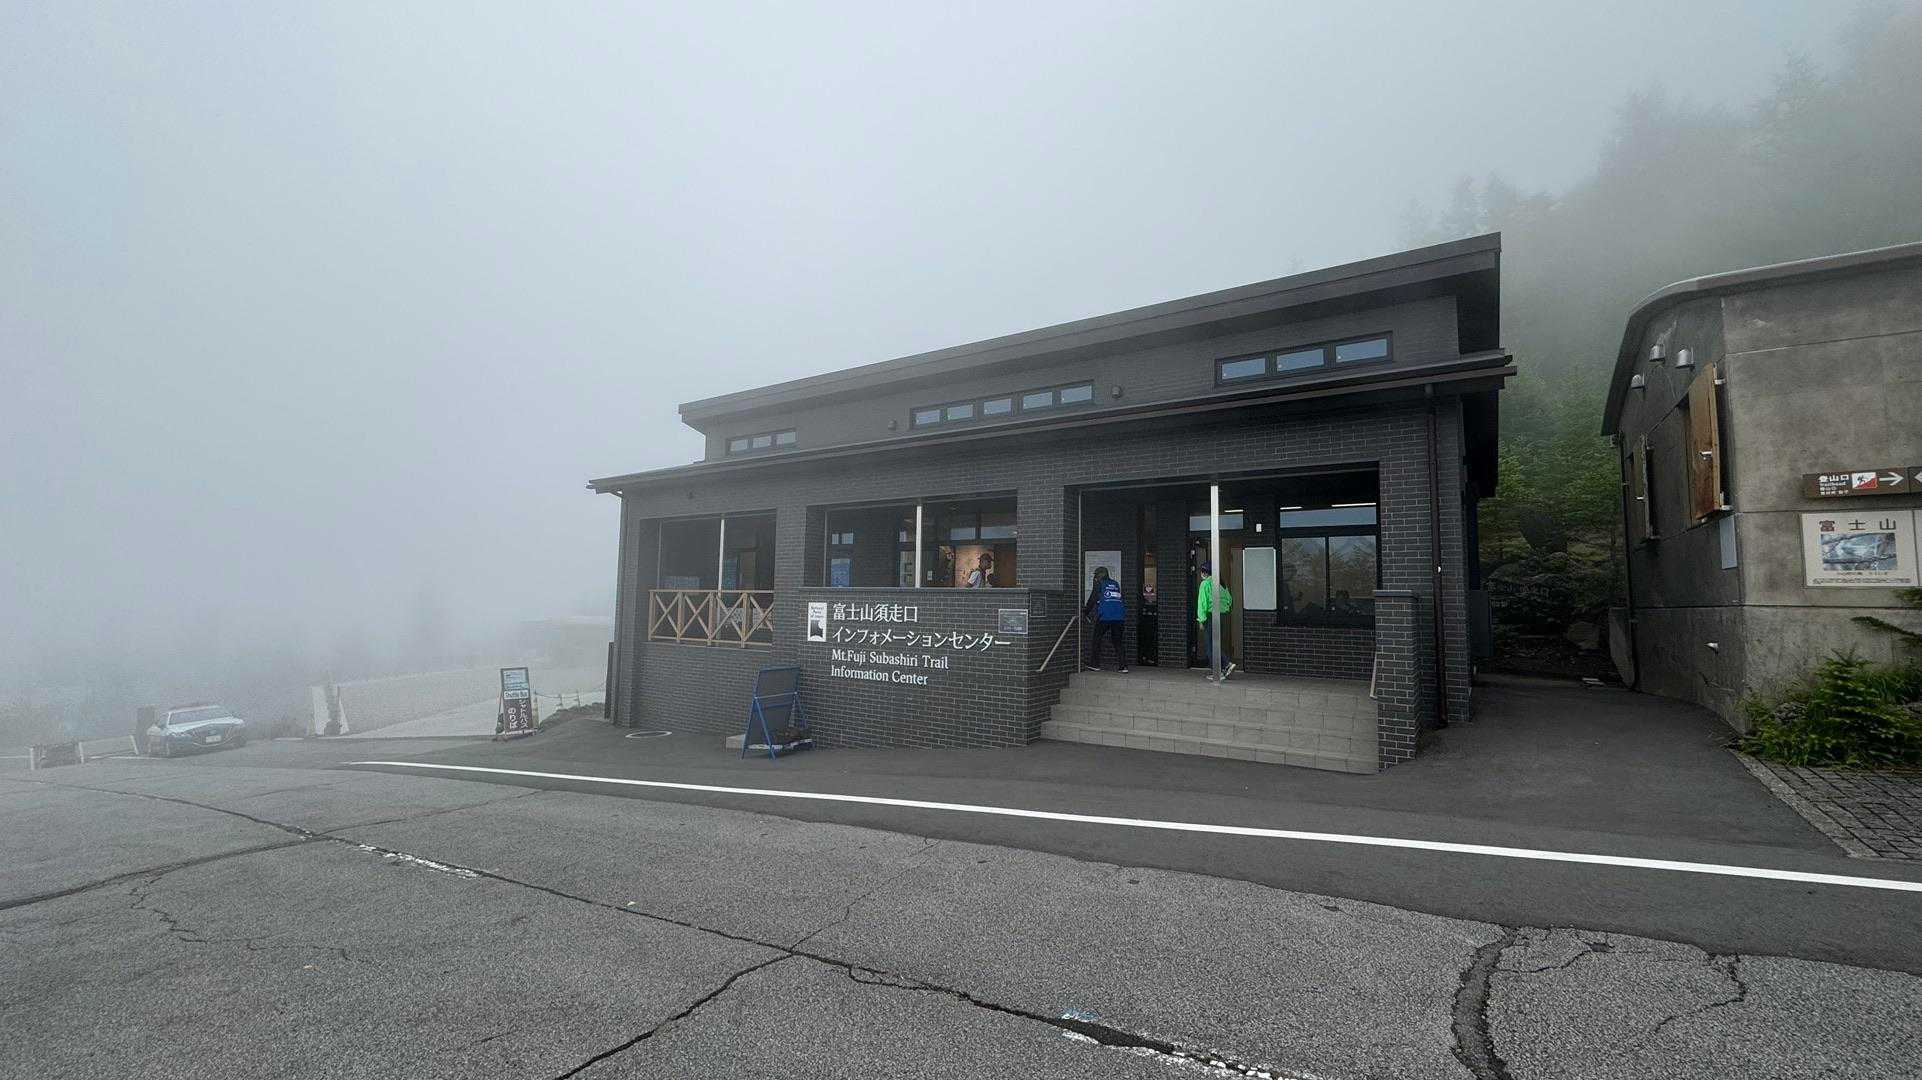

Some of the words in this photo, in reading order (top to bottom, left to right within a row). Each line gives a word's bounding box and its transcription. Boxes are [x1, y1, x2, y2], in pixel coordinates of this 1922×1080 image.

[1818, 518, 1897, 532] 富士山
[833, 602, 918, 623] 富士山須走口
[832, 626, 1012, 652] インフォメーションセンター
[869, 651, 918, 667] Subashiri
[922, 655, 949, 669] Trail
[831, 665, 889, 682] Information
[892, 670, 929, 685] Center
